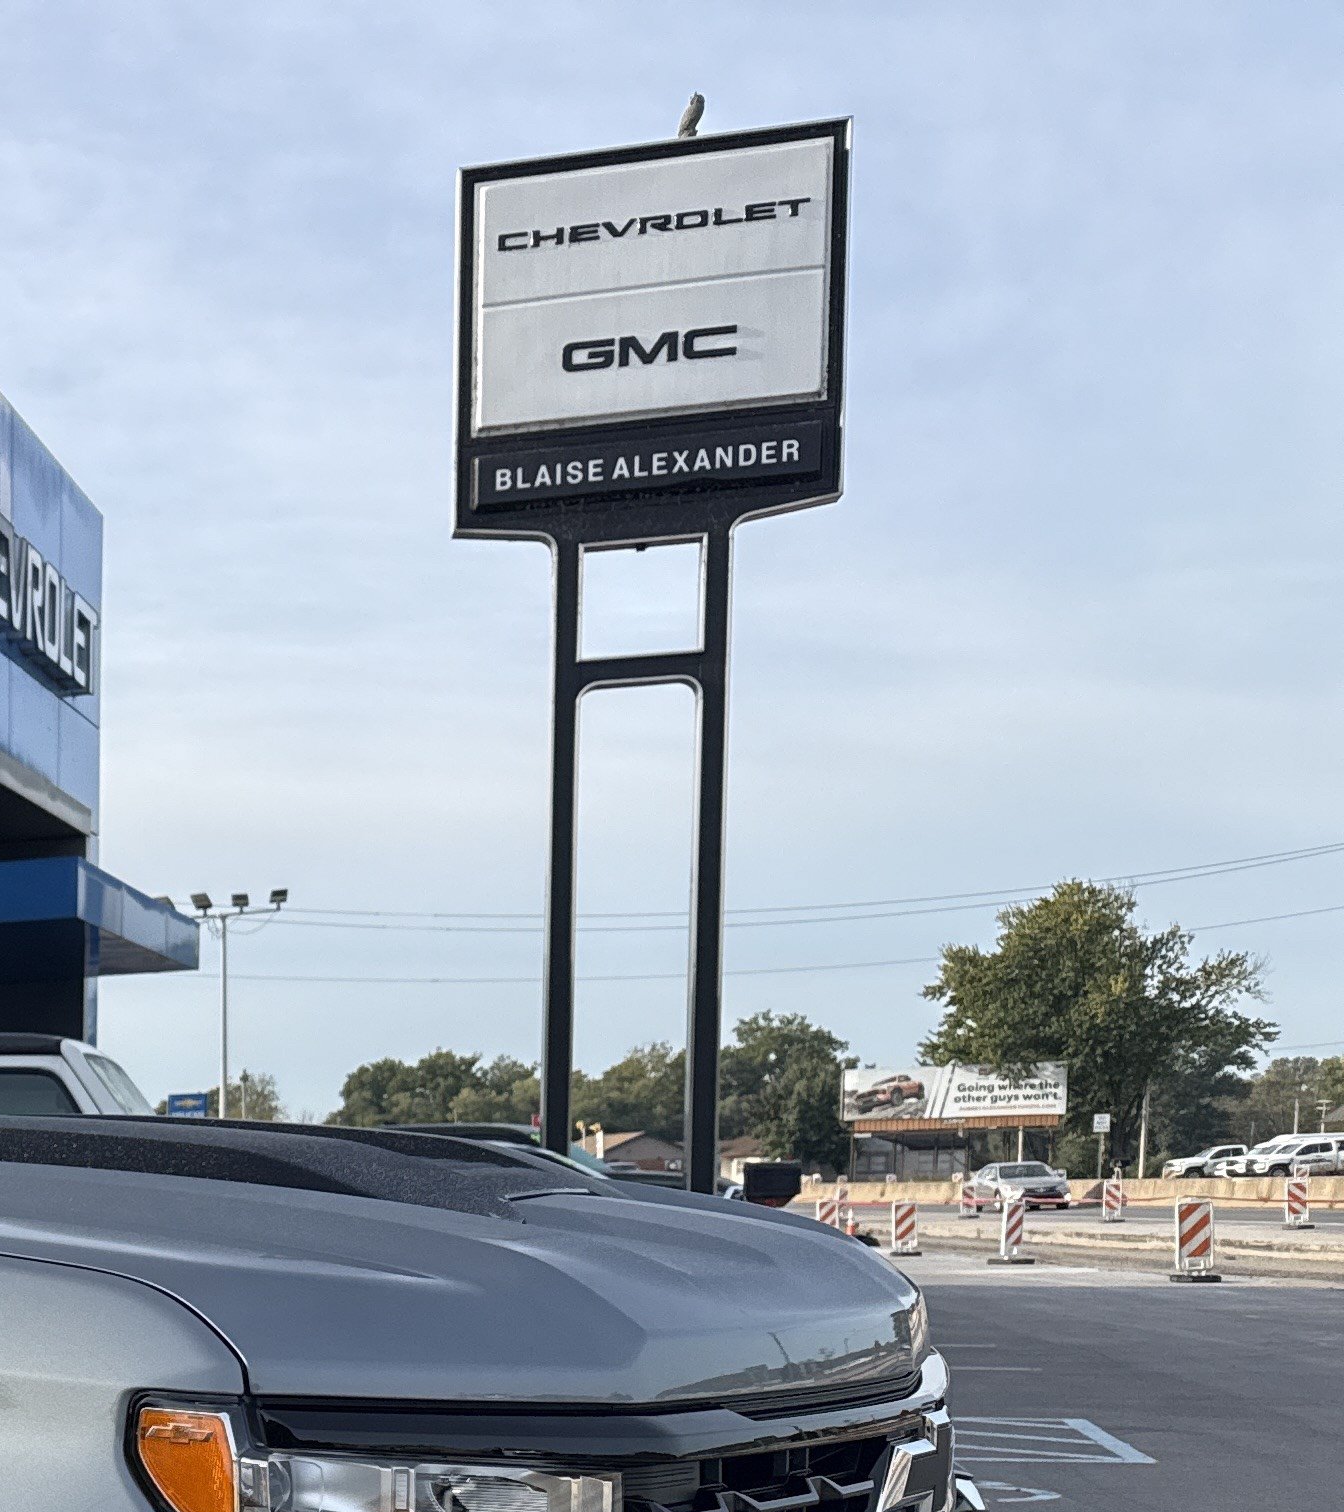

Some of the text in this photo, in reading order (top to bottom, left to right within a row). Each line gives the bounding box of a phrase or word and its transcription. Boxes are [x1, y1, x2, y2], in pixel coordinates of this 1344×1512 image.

[497, 197, 811, 252] CHEVROLET
[562, 324, 738, 372] GMC
[495, 439, 800, 492] BLAISE ALEXANDER
[953, 1093, 988, 1103] other
[990, 1093, 1020, 1104] guys
[957, 1082, 995, 1093] Going
[1039, 1079, 1060, 1090] the
